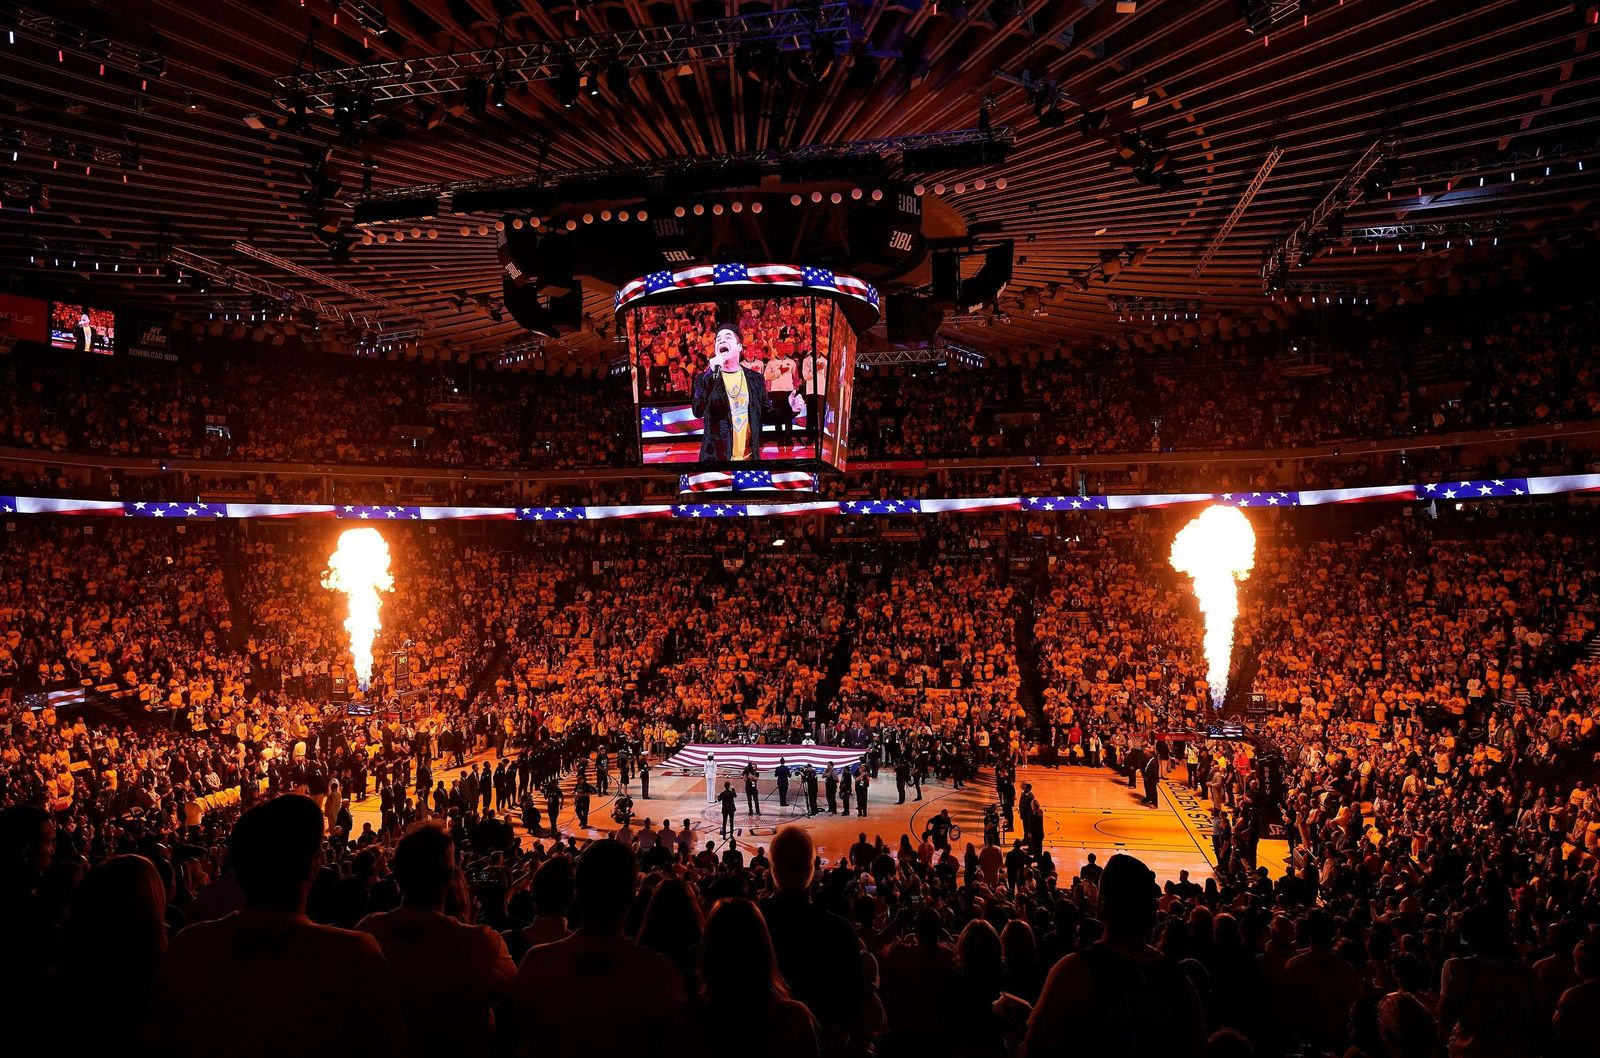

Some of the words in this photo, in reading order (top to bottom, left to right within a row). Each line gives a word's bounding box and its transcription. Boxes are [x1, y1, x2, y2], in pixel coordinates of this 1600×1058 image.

[898, 193, 921, 216] JBL
[653, 218, 685, 236] JBL
[889, 230, 913, 251] JBL
[662, 250, 696, 262] JBL
[128, 347, 163, 360] DOWNLOAD
[163, 353, 179, 362] NOW
[855, 462, 893, 470] ORACLE
